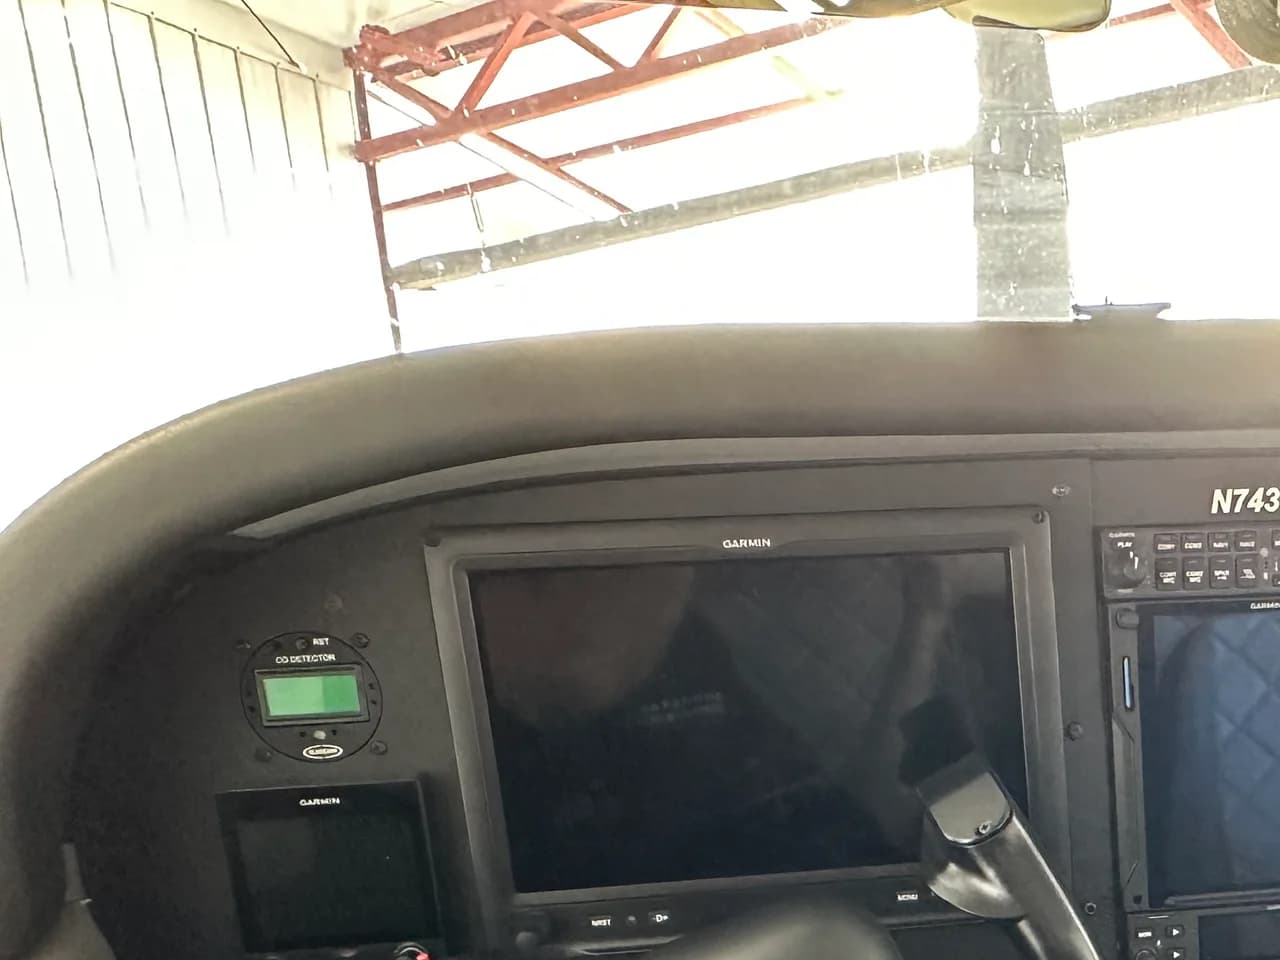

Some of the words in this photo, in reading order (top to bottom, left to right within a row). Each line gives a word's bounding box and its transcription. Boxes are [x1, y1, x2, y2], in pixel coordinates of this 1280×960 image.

[722, 538, 771, 549] GARMIN
[290, 653, 337, 664] DETECTOR
[299, 797, 341, 807] GARMIN
